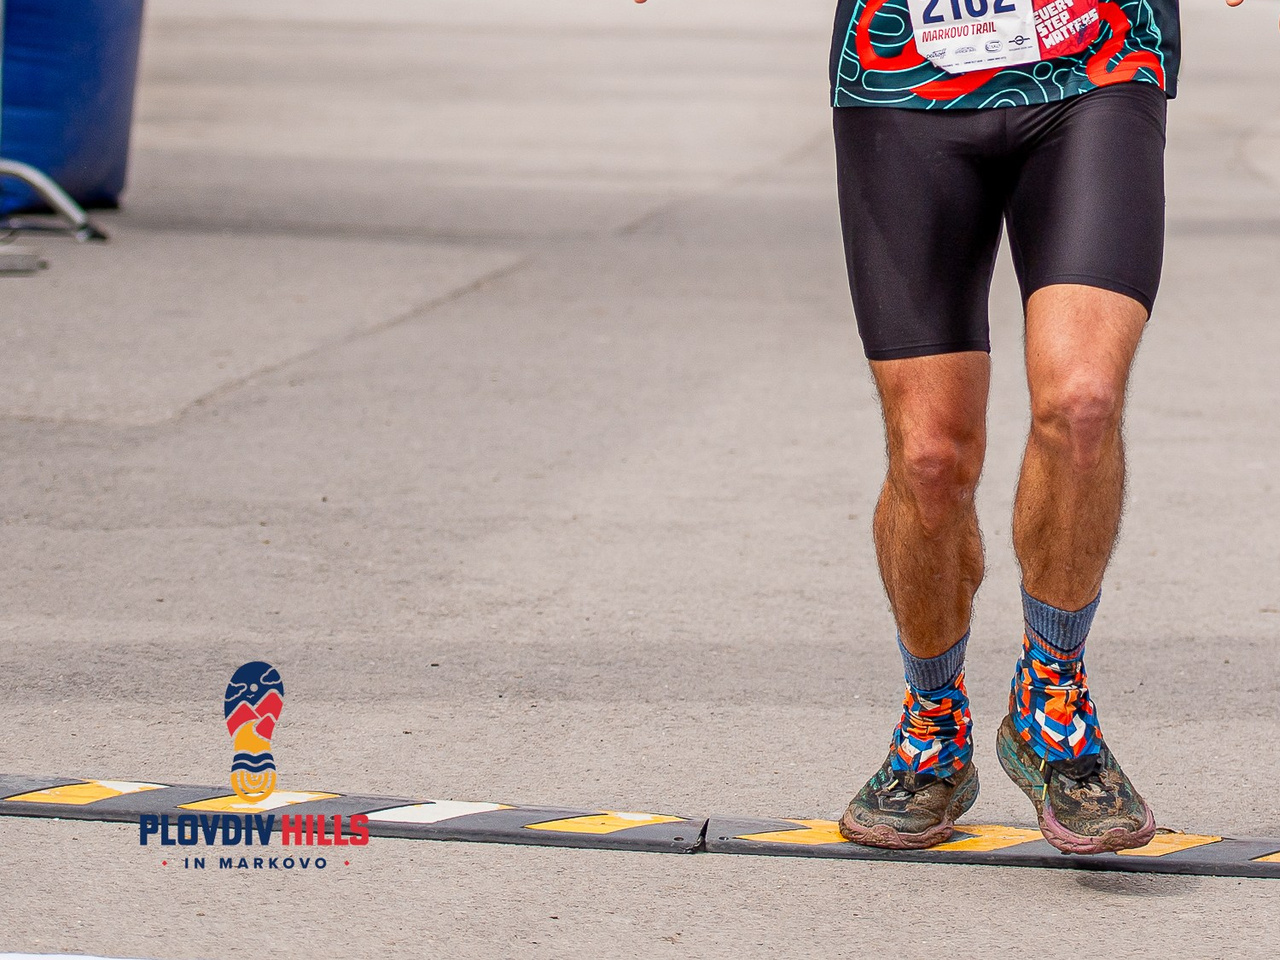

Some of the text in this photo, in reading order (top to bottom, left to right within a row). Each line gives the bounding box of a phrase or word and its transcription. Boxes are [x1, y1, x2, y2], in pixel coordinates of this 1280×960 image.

[921, 21, 997, 43] MARKOVO TRAIL
[1036, 10, 1070, 38] STEP
[1042, 7, 1099, 49] MATTERS
